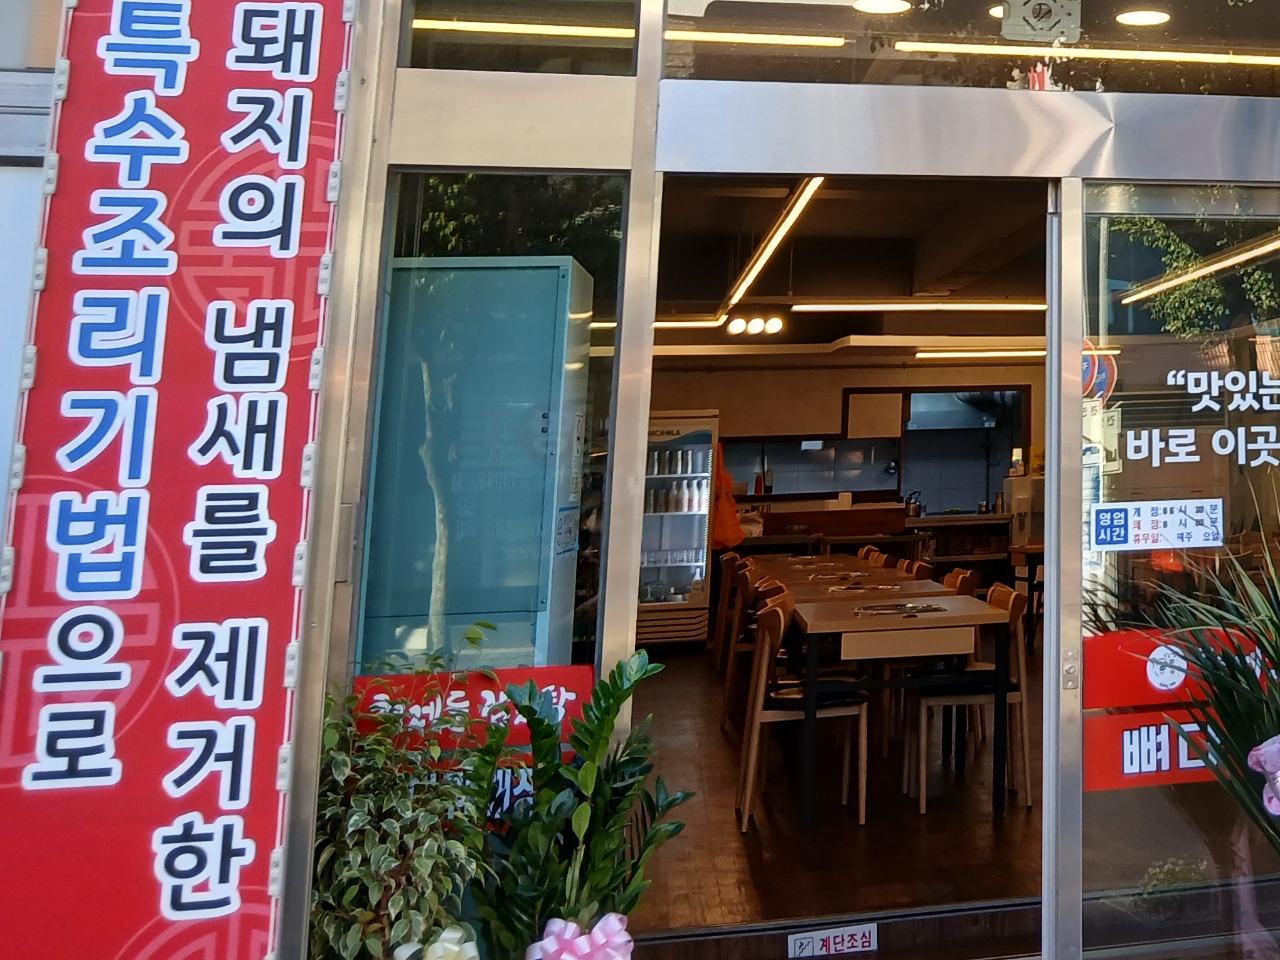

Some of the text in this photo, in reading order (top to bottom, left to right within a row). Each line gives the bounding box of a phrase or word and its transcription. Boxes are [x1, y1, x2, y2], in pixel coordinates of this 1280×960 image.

[1126, 428, 1200, 468] 바로
[152, 2, 324, 921] 돼지의 냄새를 제거한
[1099, 511, 1125, 526] 영업
[1098, 527, 1126, 542] 시간
[819, 929, 872, 954] 계단조심
